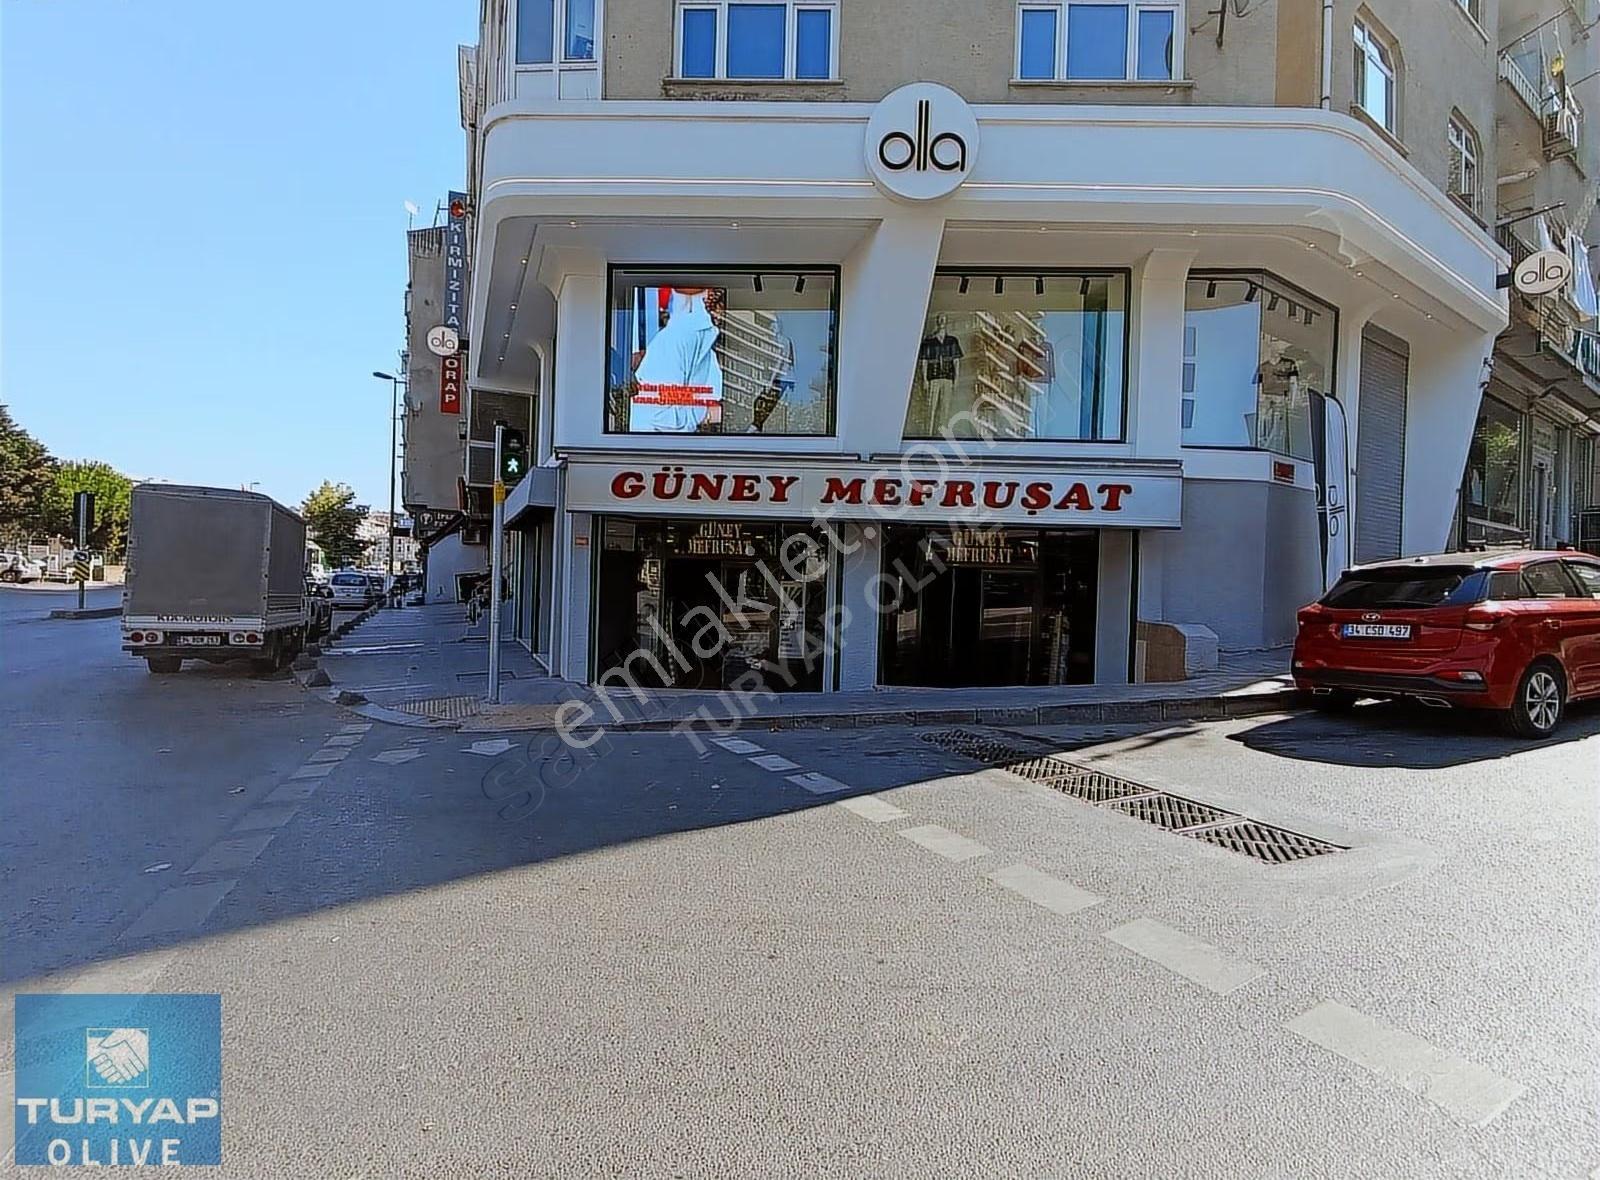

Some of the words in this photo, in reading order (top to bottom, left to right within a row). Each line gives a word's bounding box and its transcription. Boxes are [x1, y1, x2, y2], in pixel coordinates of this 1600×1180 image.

[878, 99, 966, 172] olla
[447, 222, 463, 333] KIRMIZITA
[1520, 255, 1564, 285] olla
[444, 354, 459, 402] ORAP
[610, 466, 800, 503] GÜNEY
[820, 477, 1134, 516] MEFRUŞAT
[1389, 627, 1408, 636] 497
